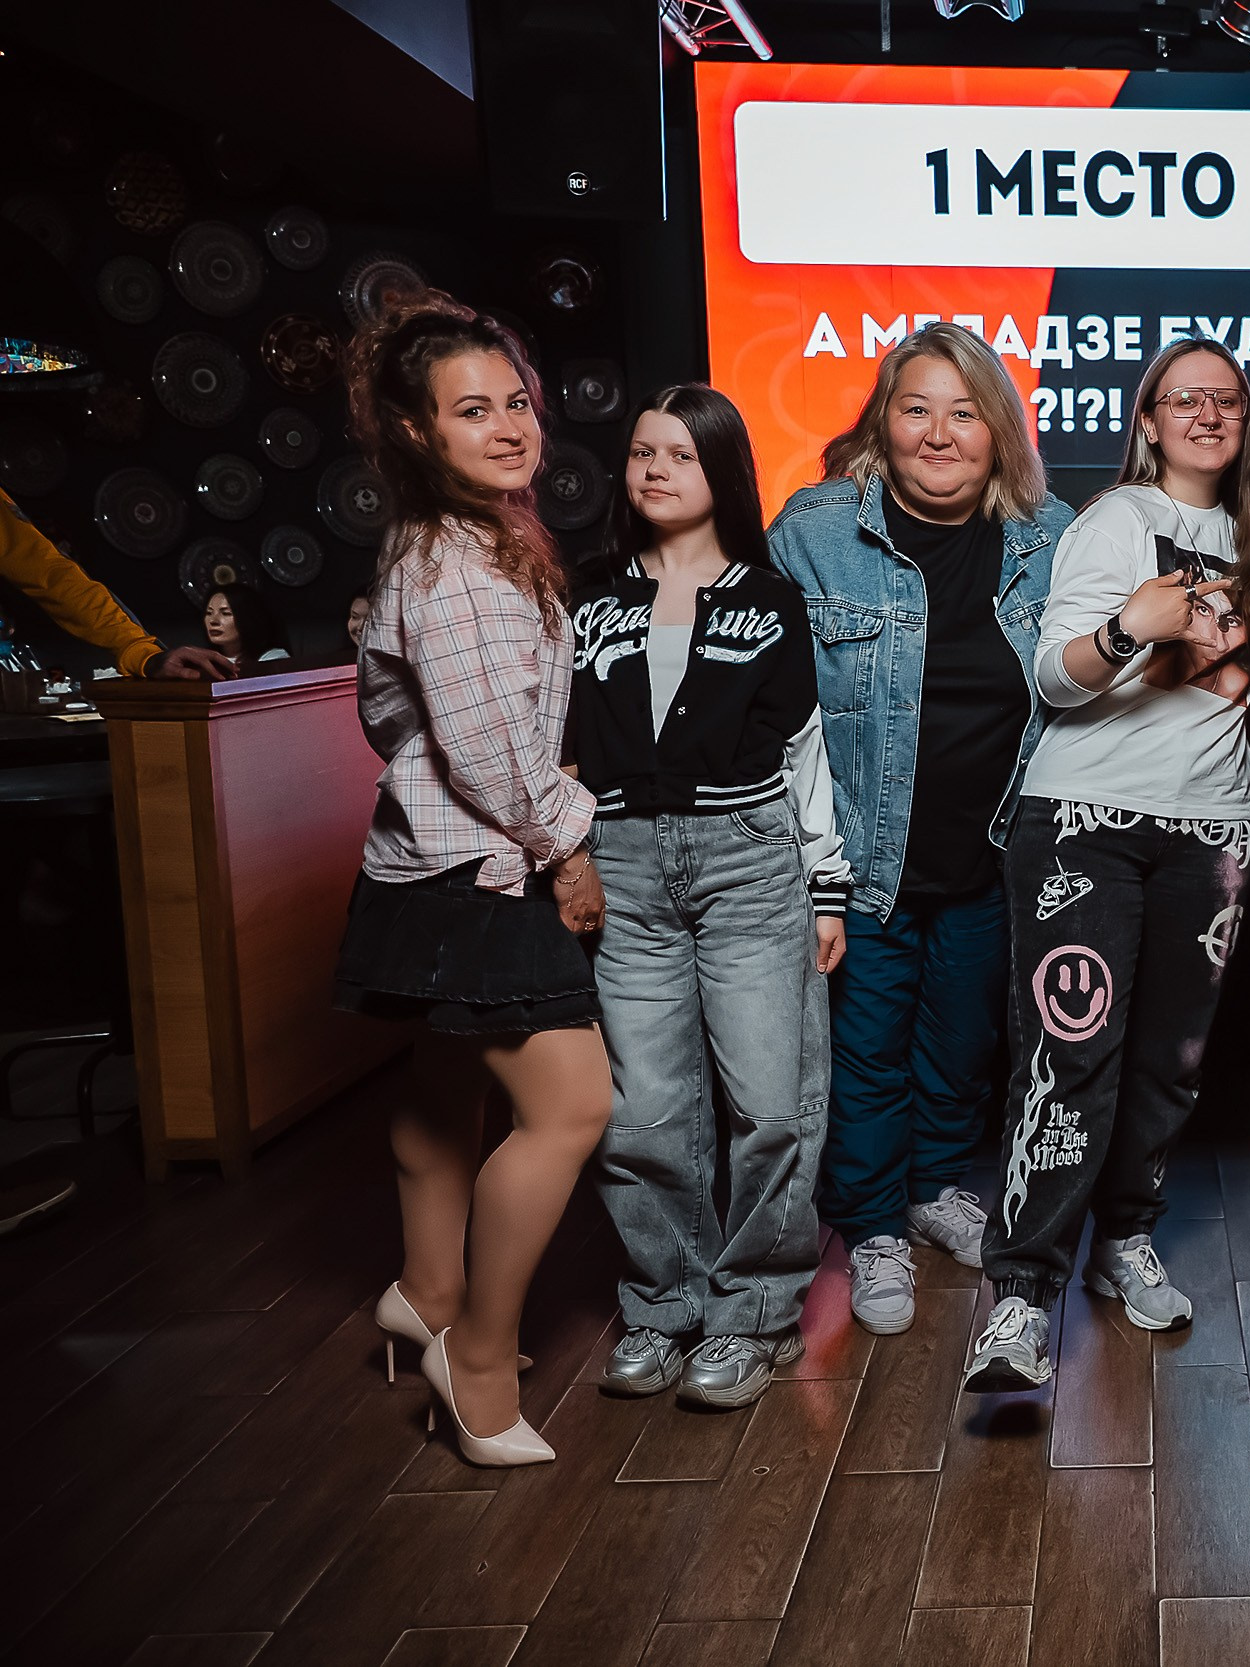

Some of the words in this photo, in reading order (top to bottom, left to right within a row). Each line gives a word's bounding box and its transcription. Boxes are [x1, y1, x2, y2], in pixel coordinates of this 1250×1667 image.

[569, 178, 588, 189] RCF
[926, 148, 950, 216] 1
[976, 149, 1235, 219] МЕСТО
[803, 311, 848, 358] А
[1034, 386, 1123, 433] ?!?!
[1031, 1142, 1083, 1171] Mood
